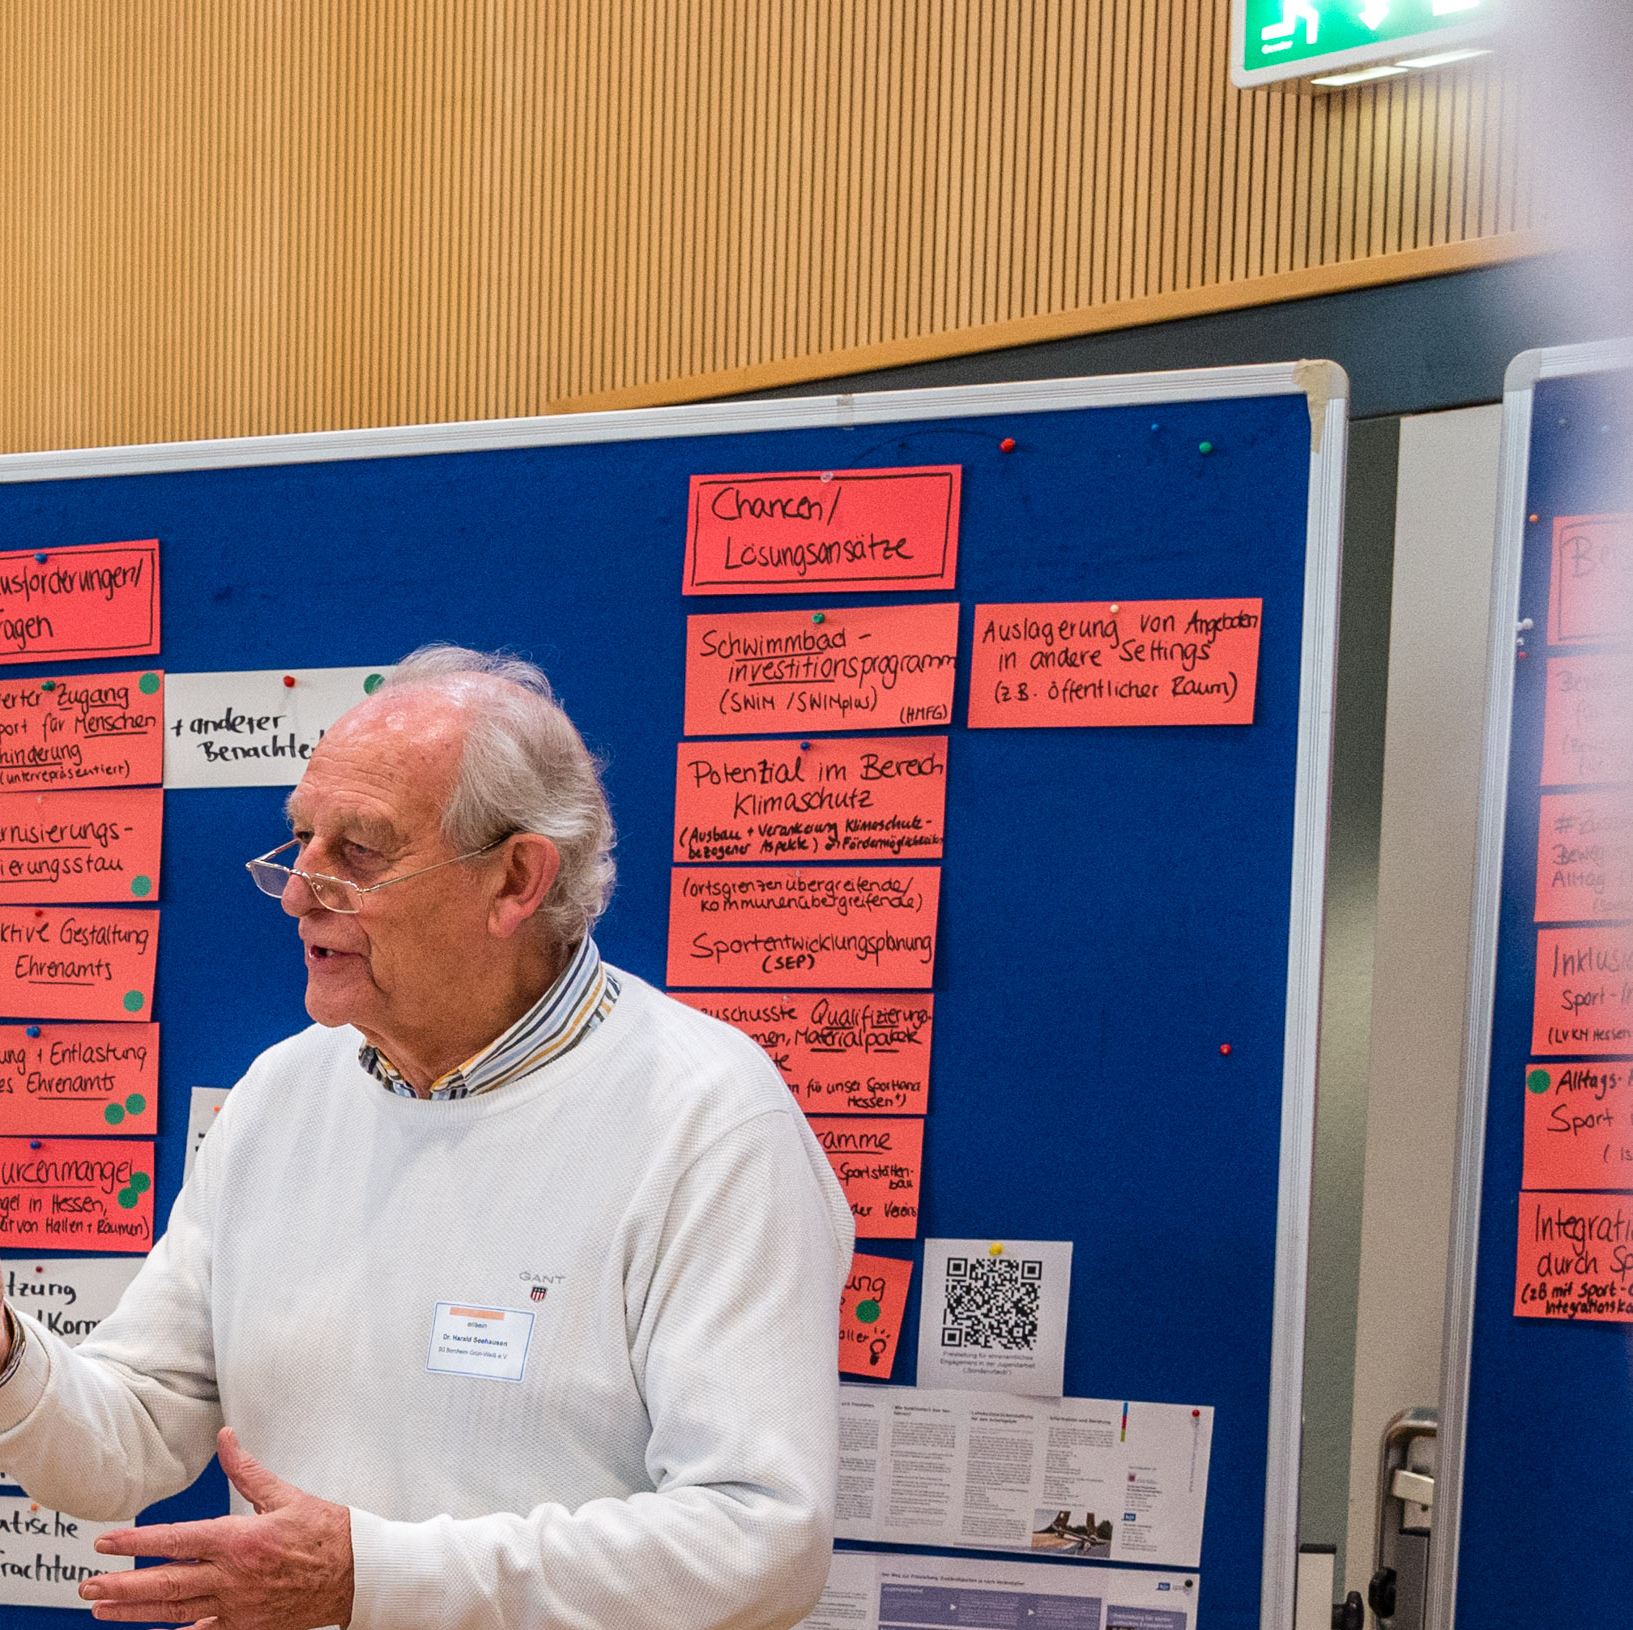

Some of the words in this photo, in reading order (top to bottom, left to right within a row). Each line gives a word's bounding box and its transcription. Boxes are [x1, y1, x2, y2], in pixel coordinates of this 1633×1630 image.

[725, 533, 914, 576] Lösungsansätze
[983, 617, 1120, 649] Auslagerung
[1140, 614, 1175, 633] von
[998, 648, 1017, 672] in
[1030, 647, 1102, 670] andere
[1119, 639, 1211, 671] Settings
[57, 683, 129, 713] Zugang
[1048, 678, 1159, 703] öffentlicher
[1171, 671, 1238, 704] Raum)
[42, 713, 65, 741] für
[75, 711, 156, 736] Menschen
[190, 707, 287, 734] anderer
[900, 704, 948, 724] (HMFG)
[688, 756, 805, 787] Potenzial
[818, 762, 847, 782] im
[734, 787, 874, 819] Klimaschutz
[679, 826, 741, 848] (Ausbau
[60, 918, 149, 955] Gestaltung
[690, 930, 932, 966] Sportentwicklungsplanung
[15, 954, 112, 981] Ehrenamts
[762, 954, 815, 973] (SEP)
[50, 1041, 147, 1073] Entlastung
[26, 1072, 116, 1094] Ehrenamts
[1547, 1104, 1614, 1136] Sport
[889, 1179, 913, 1190] bau
[29, 1196, 42, 1213] in
[52, 1194, 108, 1217] Hessen,
[18, 1220, 39, 1234] von
[45, 1217, 84, 1235] Hallen
[97, 1216, 151, 1241] Räumen)
[1535, 1204, 1633, 1257] Integrati
[518, 1271, 566, 1285] GANT
[1537, 1250, 1598, 1278] durch
[5, 1271, 77, 1306] tzung
[1552, 1281, 1573, 1298] mit
